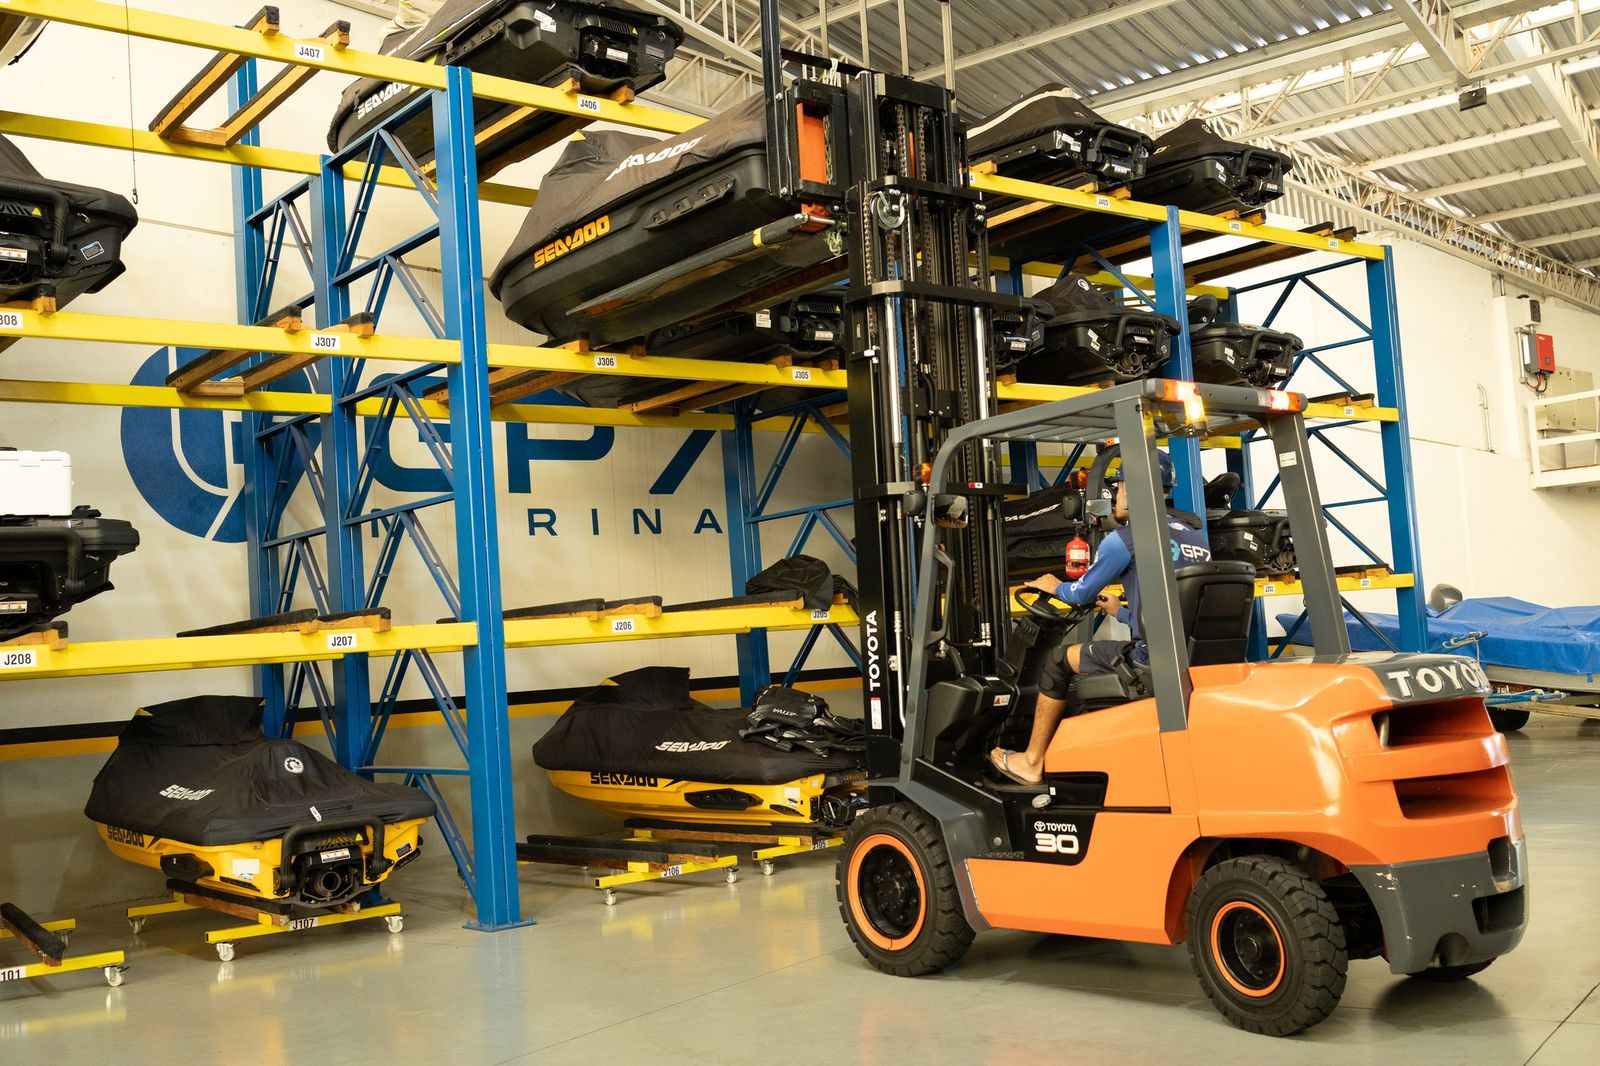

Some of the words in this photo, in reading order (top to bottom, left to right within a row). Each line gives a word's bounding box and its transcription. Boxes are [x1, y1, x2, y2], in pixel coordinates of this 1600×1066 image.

[299, 46, 320, 59] J407
[580, 99, 597, 110] J406
[315, 336, 336, 348] J307
[597, 356, 615, 367] J306
[795, 370, 809, 380] J305
[1180, 543, 1212, 562] GP7
[813, 609, 828, 619] J205
[614, 621, 632, 631] J206
[331, 636, 353, 647] J207
[866, 610, 881, 692] TOYOTA
[4, 653, 32, 665] J208
[1046, 823, 1078, 833] TOYOTA
[1035, 833, 1079, 855] 30
[664, 866, 680, 877] J106
[293, 918, 315, 930] J107
